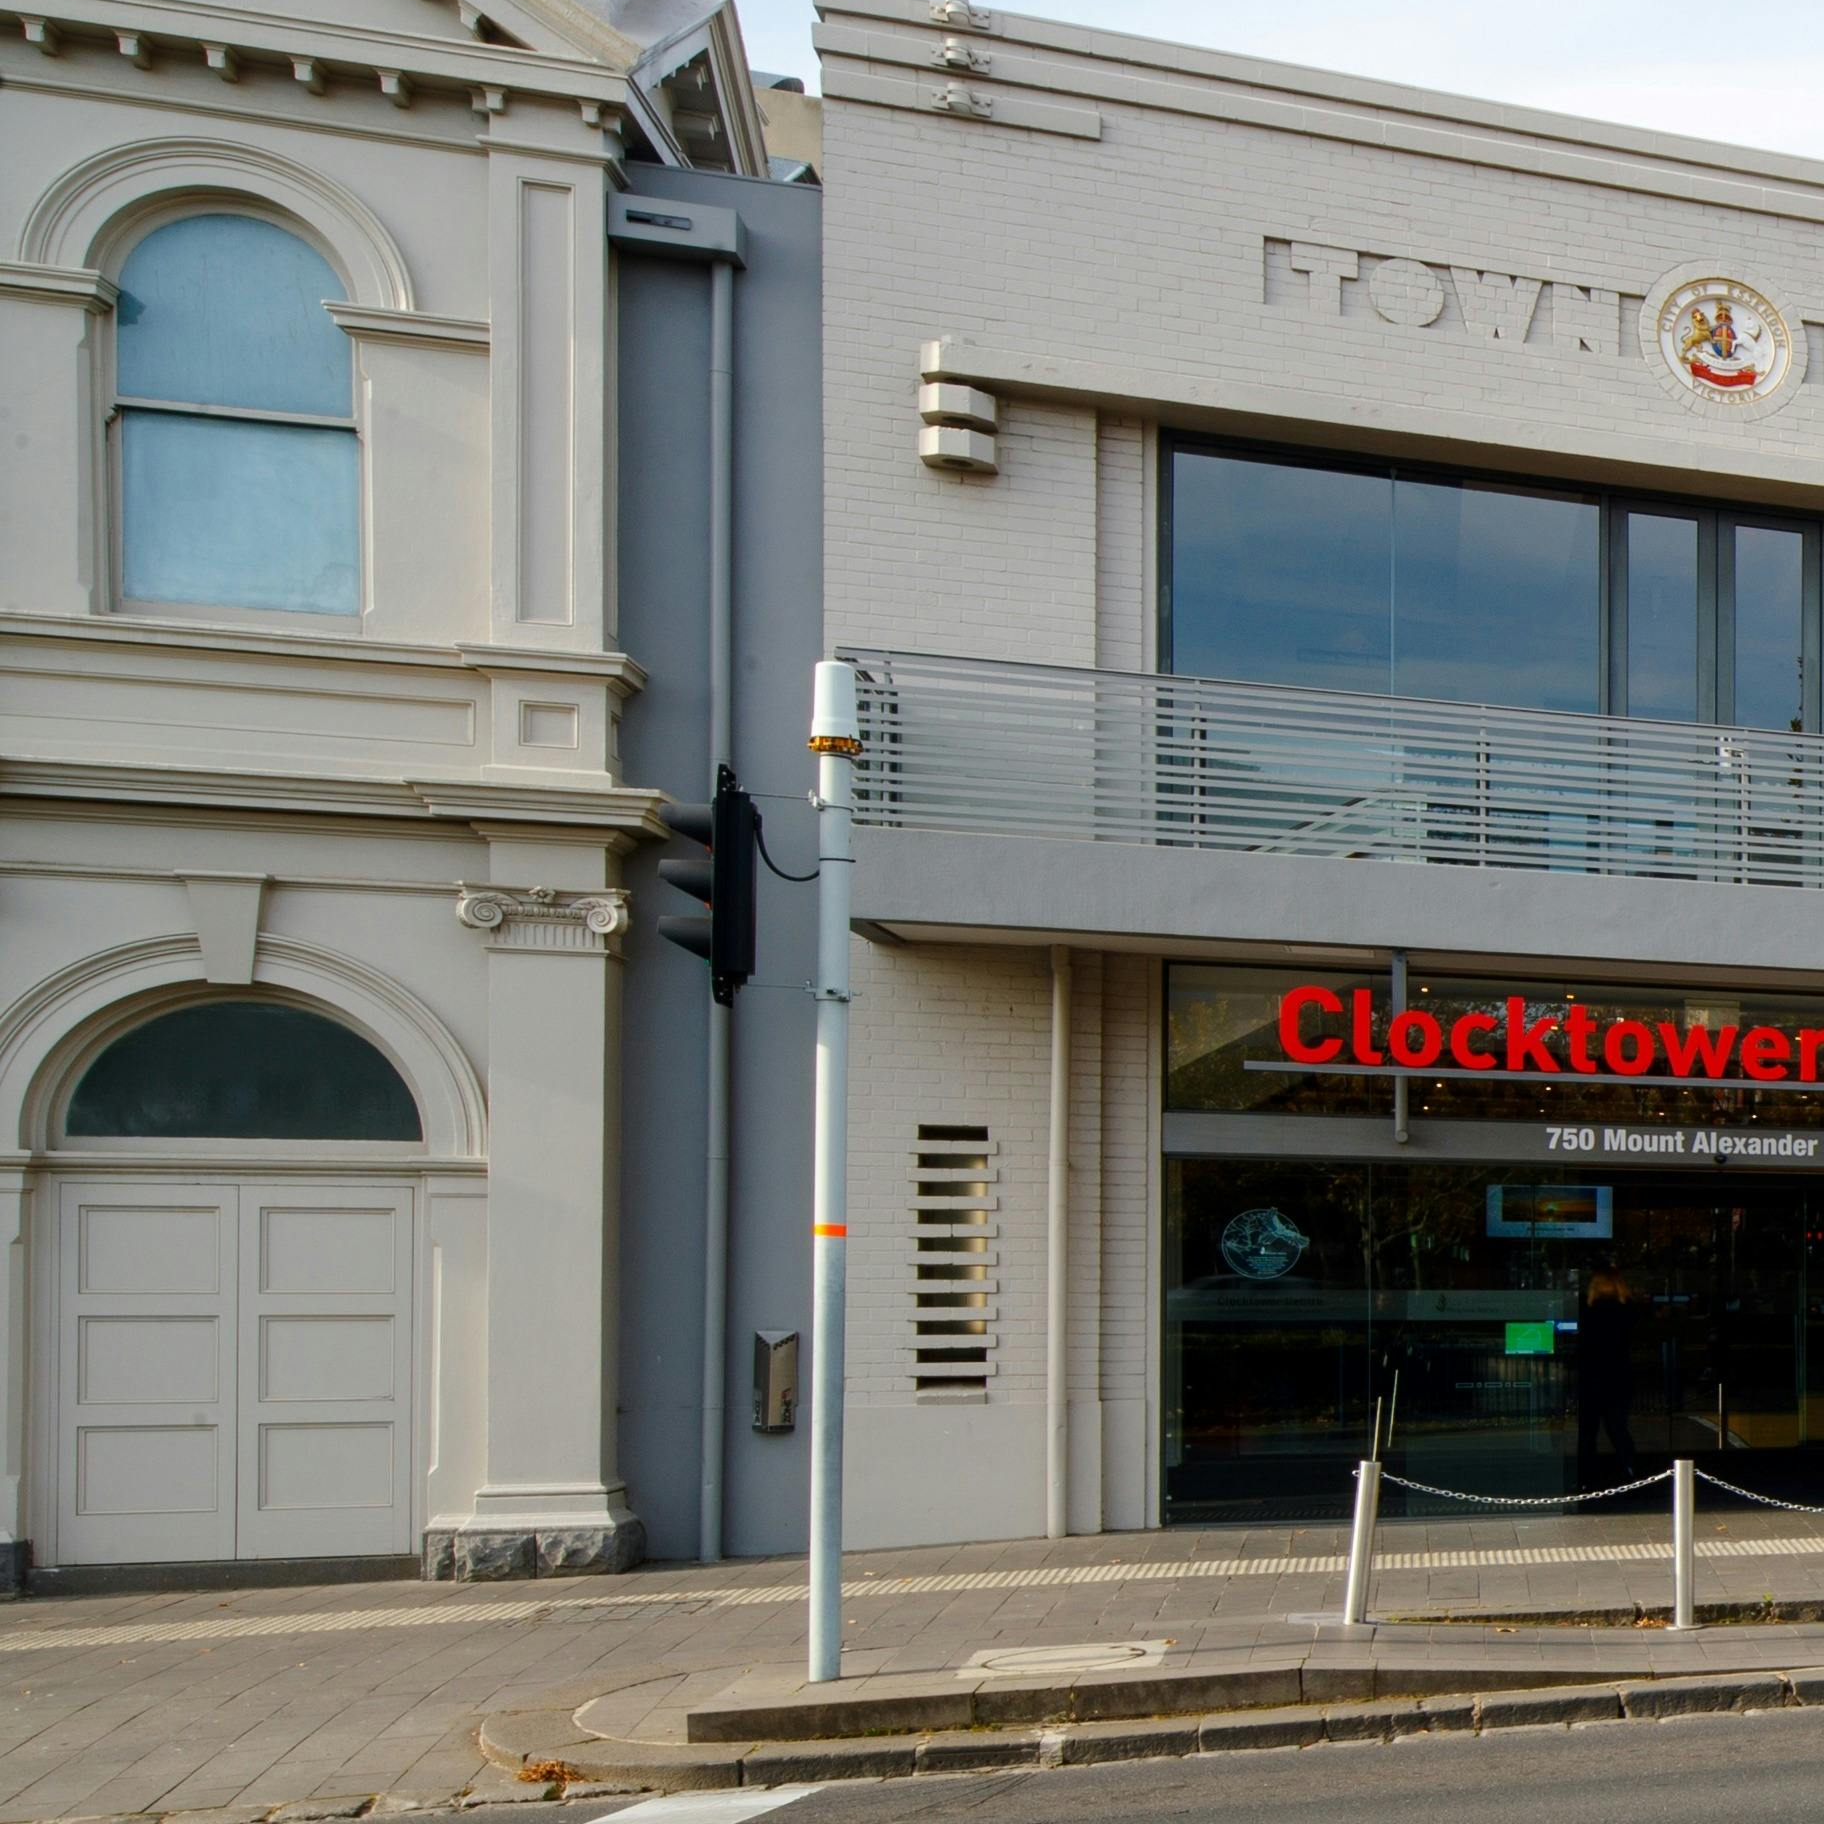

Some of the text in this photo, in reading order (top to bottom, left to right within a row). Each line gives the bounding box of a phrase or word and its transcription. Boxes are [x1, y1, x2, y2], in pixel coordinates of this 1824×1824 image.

[1291, 241, 1620, 356] TOWN
[1661, 300, 1682, 333] CITY
[1691, 377, 1761, 405] VICTORIA
[1546, 1127, 1596, 1151] 750
[1603, 1129, 1685, 1153] Mount
[1691, 1131, 1818, 1157] Alexander
